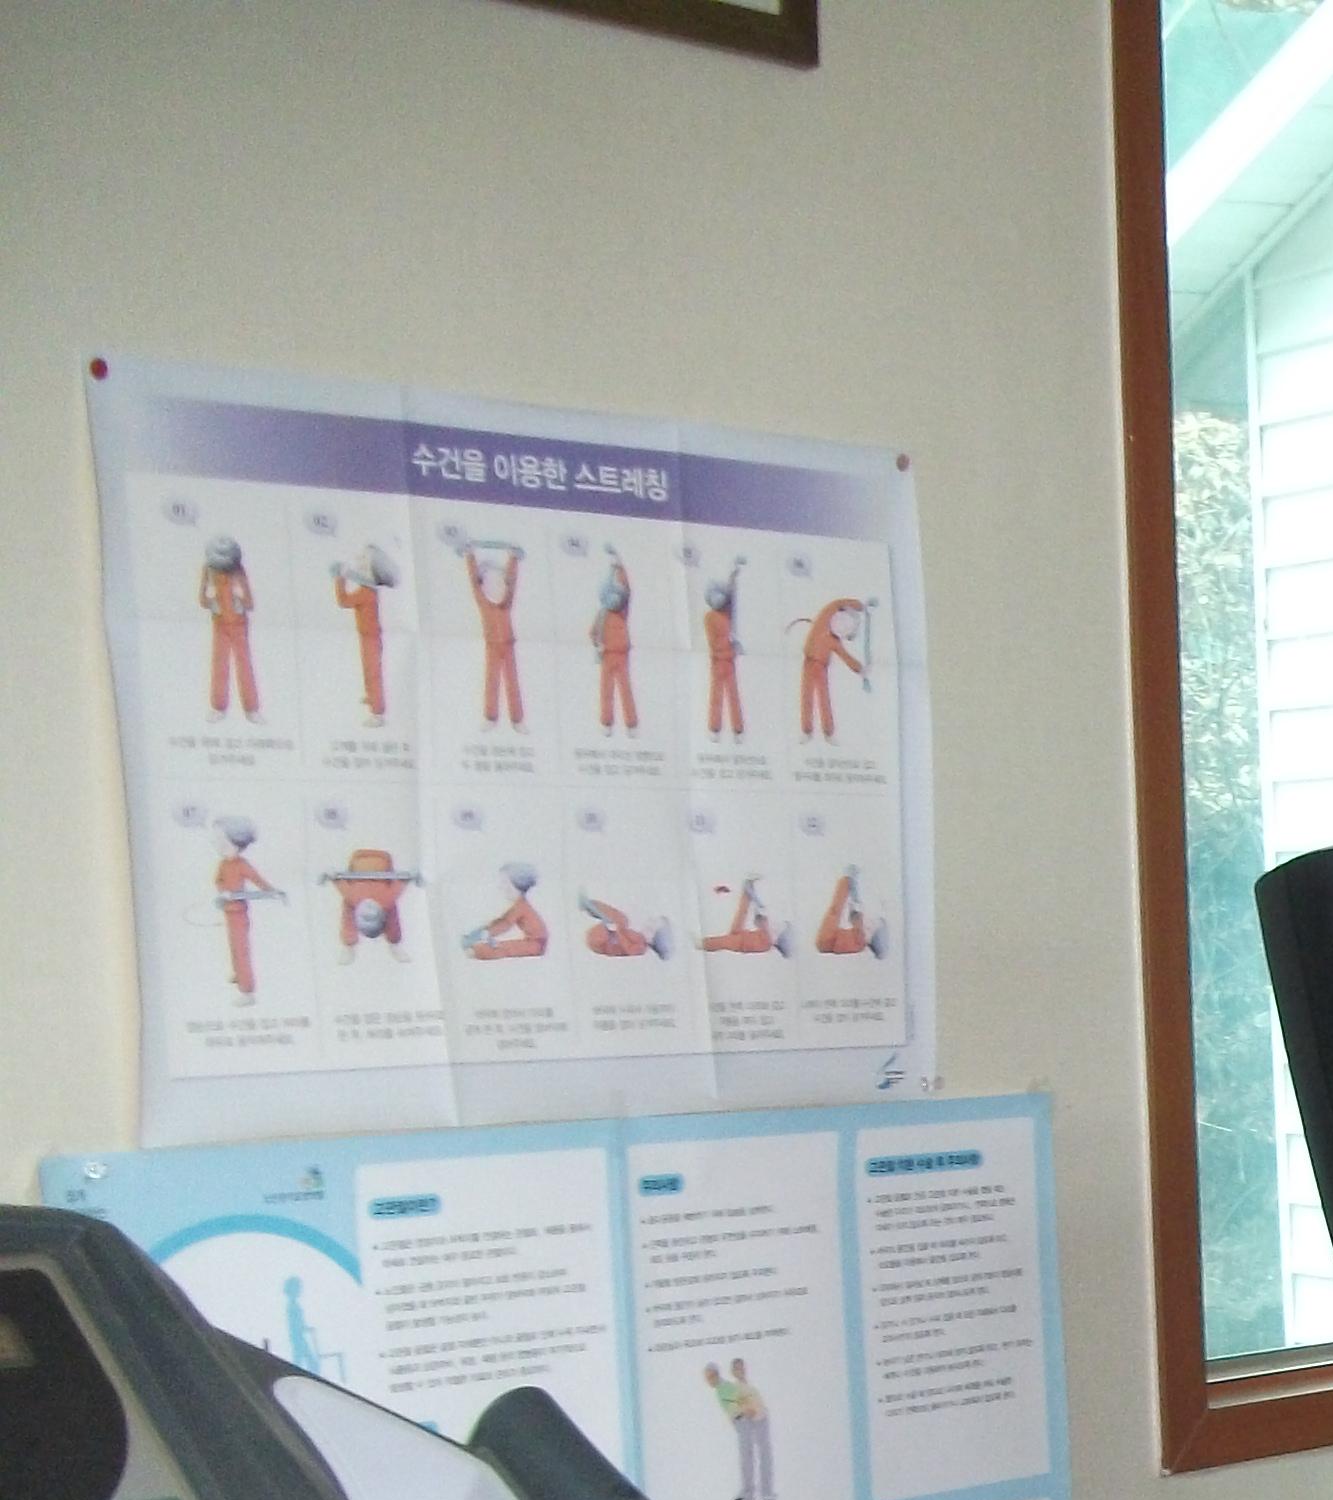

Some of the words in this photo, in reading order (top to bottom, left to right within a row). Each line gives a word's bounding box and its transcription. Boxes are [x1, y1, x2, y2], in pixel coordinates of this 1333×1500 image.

[411, 443, 487, 484] 수건을
[493, 453, 568, 491] 이용한
[574, 462, 670, 502] 스트레칭
